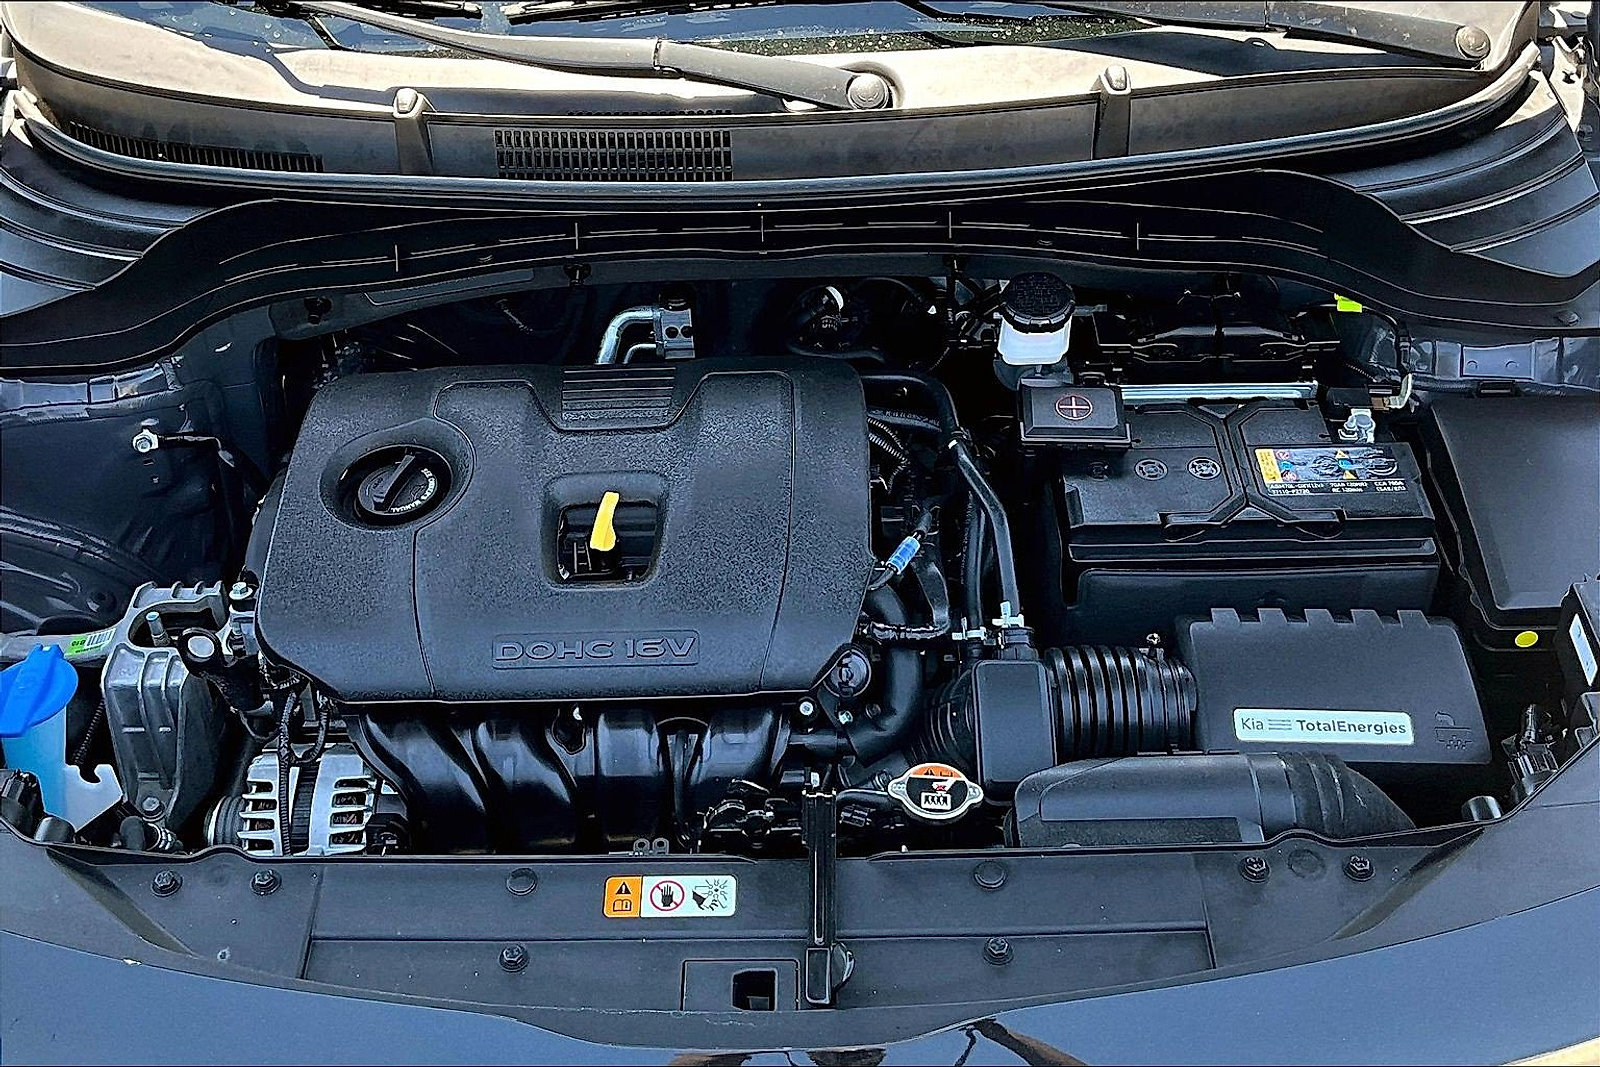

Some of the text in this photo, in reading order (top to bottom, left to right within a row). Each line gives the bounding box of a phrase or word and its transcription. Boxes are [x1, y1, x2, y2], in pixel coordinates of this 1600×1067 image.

[391, 499, 422, 513] MANUAL
[495, 636, 697, 661] DOHC 16V
[1241, 717, 1407, 736] Kia TotalEnergies
